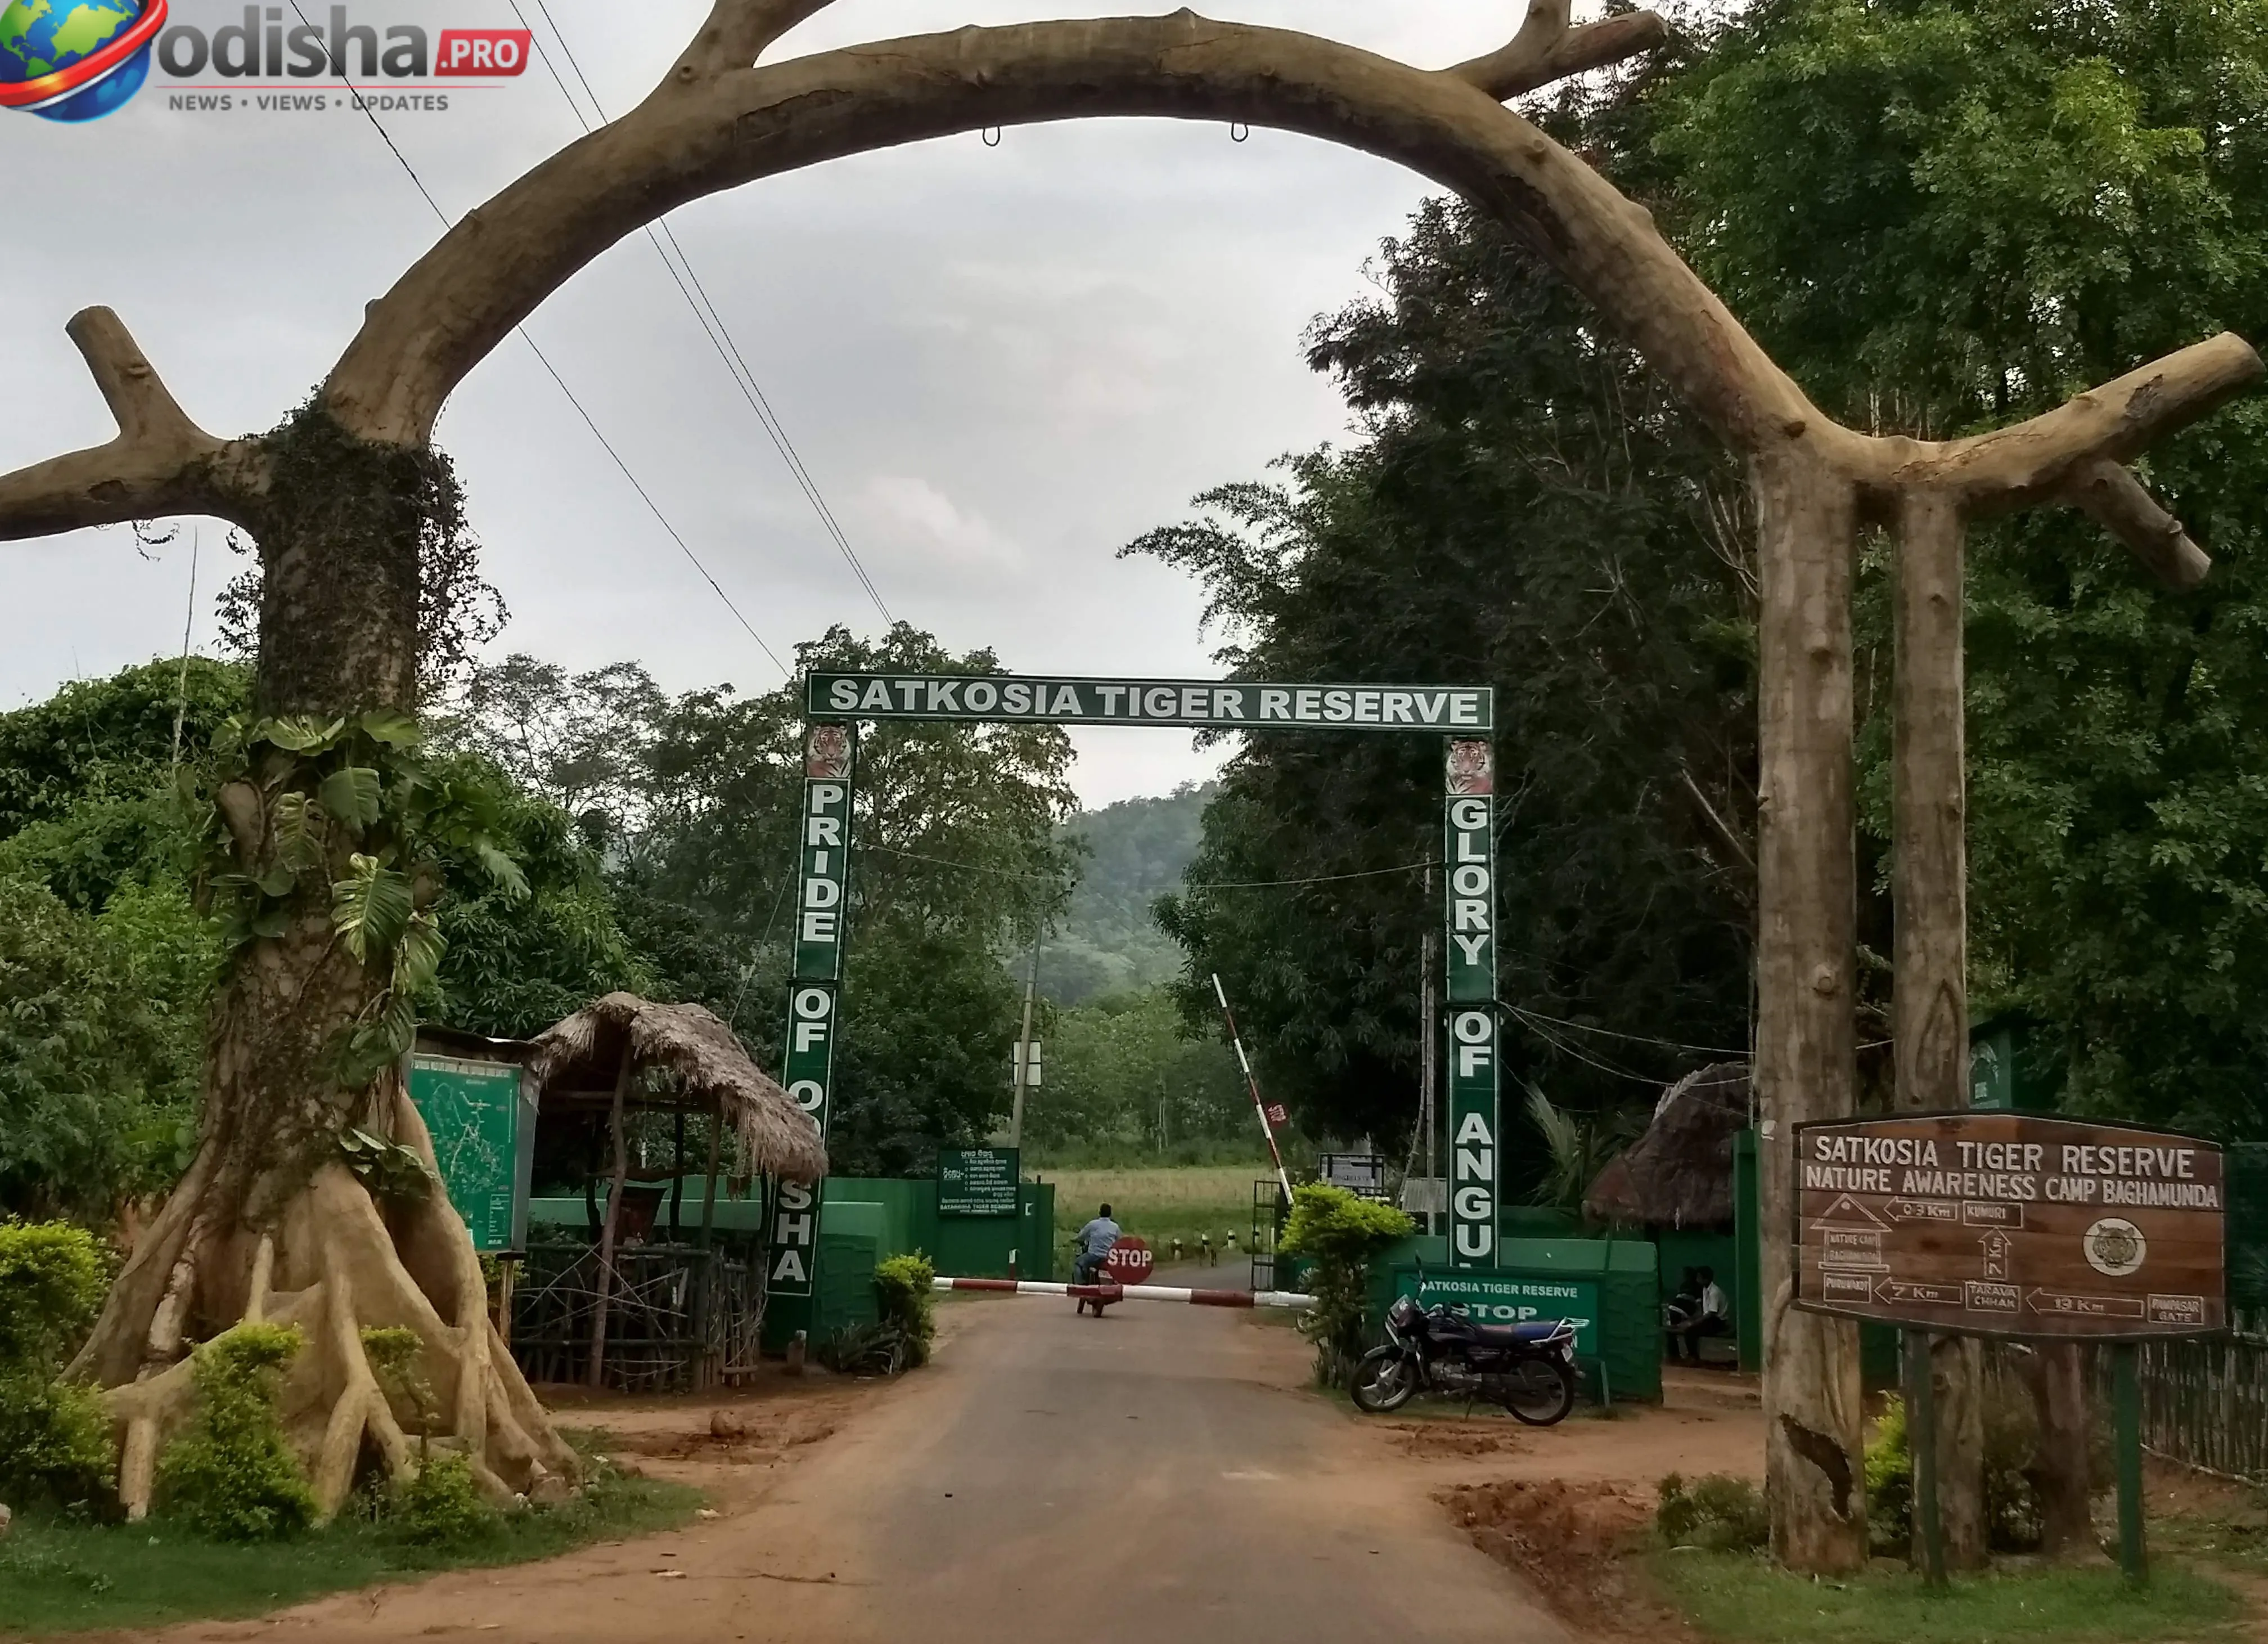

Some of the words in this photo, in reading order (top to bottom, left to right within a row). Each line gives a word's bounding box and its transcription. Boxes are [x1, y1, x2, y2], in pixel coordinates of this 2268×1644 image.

[830, 679, 1083, 715] SATKOSIA
[1095, 686, 1245, 719] TIGER
[1259, 689, 1478, 724] RESERVE
[803, 784, 843, 942] PRIDE
[1451, 799, 1491, 965] GLORY
[795, 989, 830, 1053] OF
[1454, 1012, 1492, 1077] OF
[1814, 1135, 1938, 1167] SATKOSIA
[1956, 1141, 2044, 1172] TIGER
[2062, 1144, 2195, 1178] RESERVE
[772, 1080, 823, 1282] OSHA
[1454, 1112, 1493, 1268] ANGU
[1806, 1165, 1892, 1192] NATURE
[1902, 1169, 2036, 1201] AWARENESS
[2045, 1175, 2096, 1202] CAMP
[2102, 1179, 2218, 1208] BAGHAMUNDA
[1106, 1248, 1152, 1267] STOP
[1421, 1281, 1479, 1293] ATKOSIA
[1482, 1283, 1519, 1295] TIGER
[1522, 1285, 1578, 1298] RESERVE
[1892, 1285, 1906, 1296] 7
[1912, 1287, 1940, 1299] Km
[2077, 1299, 2105, 1312] Km
[2158, 1311, 2192, 1323] GATE
